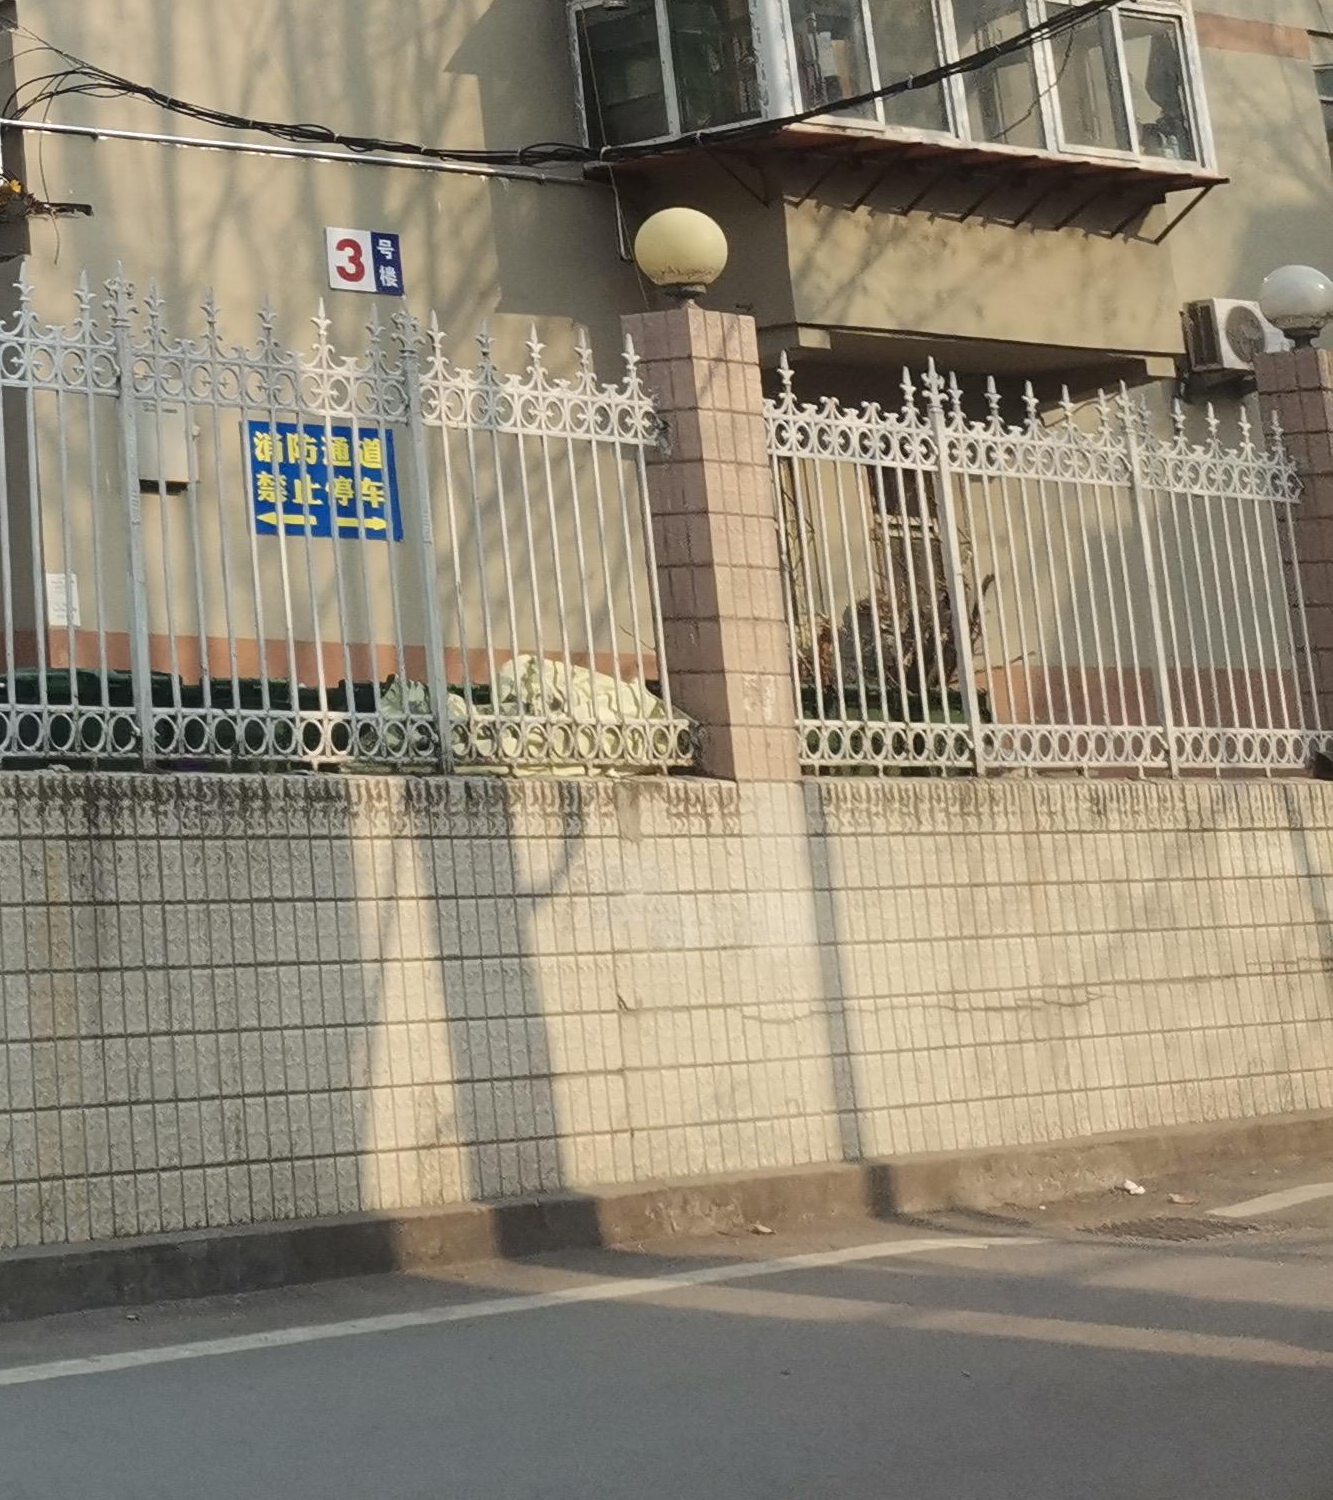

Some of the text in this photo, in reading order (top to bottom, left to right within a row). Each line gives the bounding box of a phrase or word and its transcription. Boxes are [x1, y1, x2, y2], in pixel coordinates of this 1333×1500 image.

[336, 238, 366, 283] 3
[376, 238, 400, 288] 号楼
[253, 430, 383, 469] 消防通道
[255, 470, 386, 509] 禁止停车
